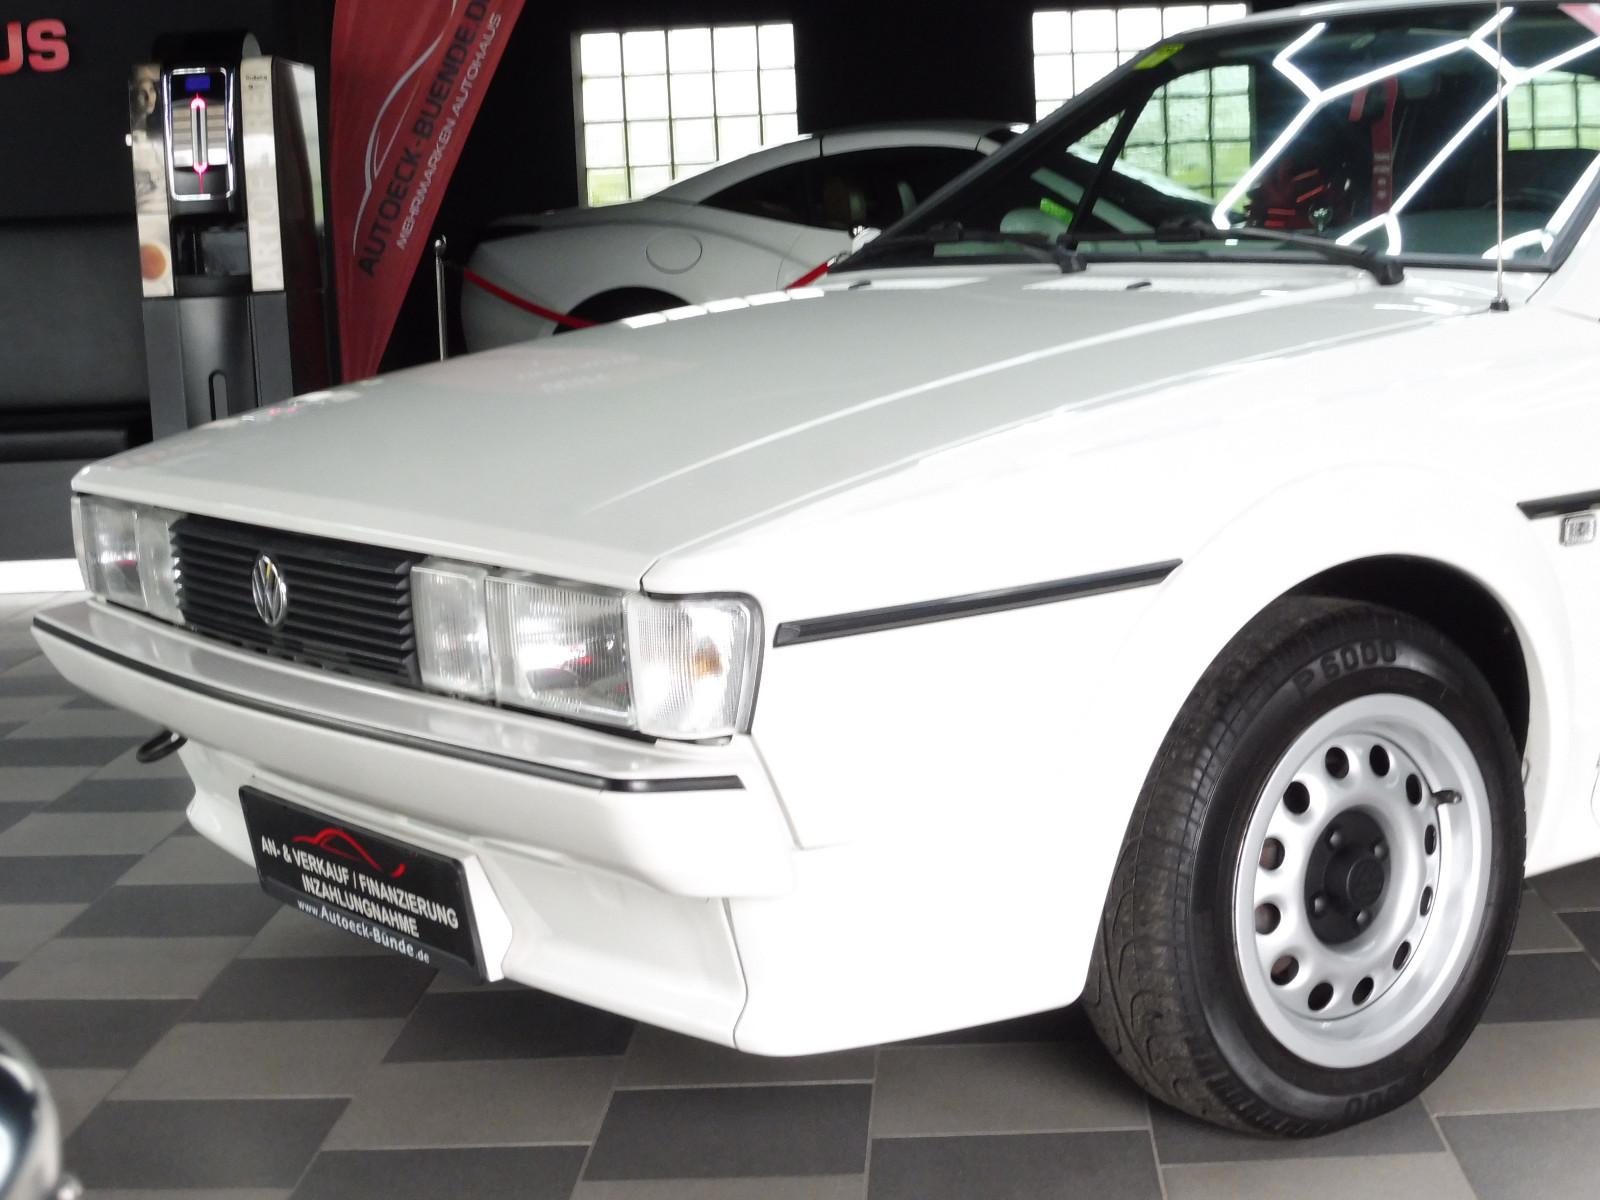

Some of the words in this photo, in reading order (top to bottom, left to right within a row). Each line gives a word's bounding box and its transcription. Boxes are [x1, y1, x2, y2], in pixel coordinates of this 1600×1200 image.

[357, 0, 491, 278] AUTOECK-BUENDE.D
[396, 116, 456, 250] MEHRMARKEN
[452, 13, 502, 118] AUTOHAUS
[261, 834, 281, 858] AN-
[282, 843, 293, 864] &
[291, 847, 350, 886] VERKAUF
[358, 873, 459, 930] FINANZIERUNG
[301, 873, 420, 938] INZAHLUNGNAHME
